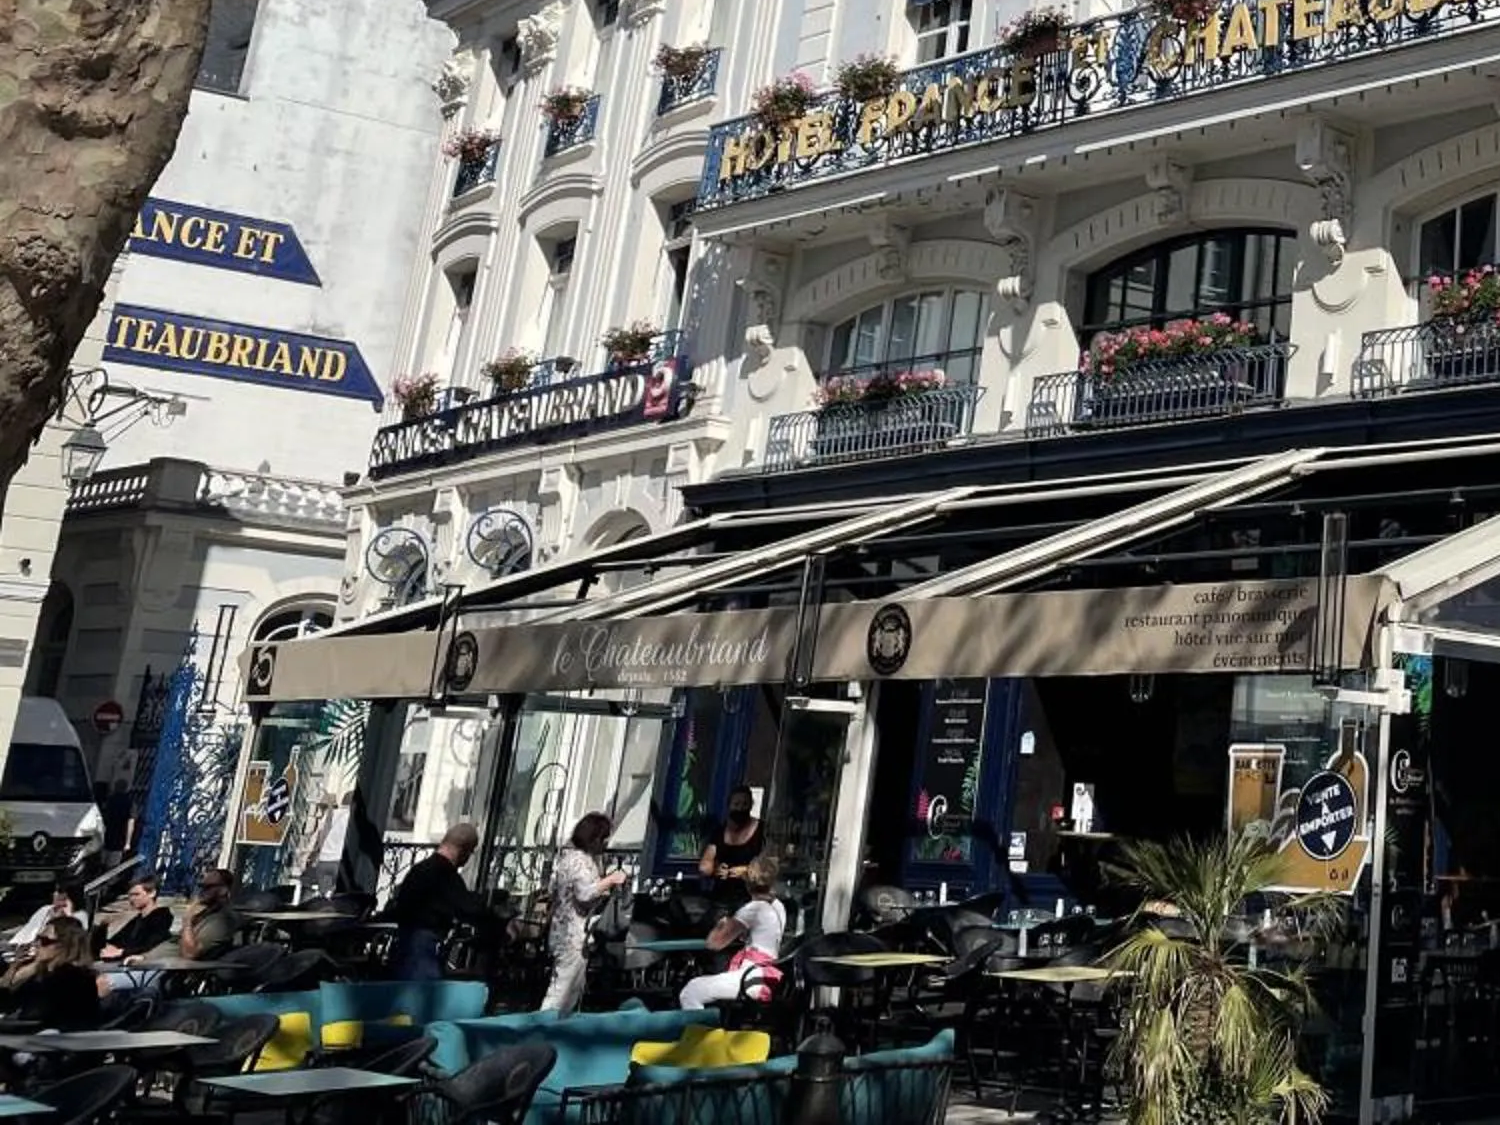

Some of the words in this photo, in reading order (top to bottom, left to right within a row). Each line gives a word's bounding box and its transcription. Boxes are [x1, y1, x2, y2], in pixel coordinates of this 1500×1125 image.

[856, 53, 1037, 146] FRANCE
[233, 225, 284, 264] ET
[103, 315, 348, 382] TEAUBRIAND
[1124, 613, 1198, 629] restaurant
[1306, 783, 1341, 805] VENTE
[1300, 805, 1353, 836] EMPORTER
